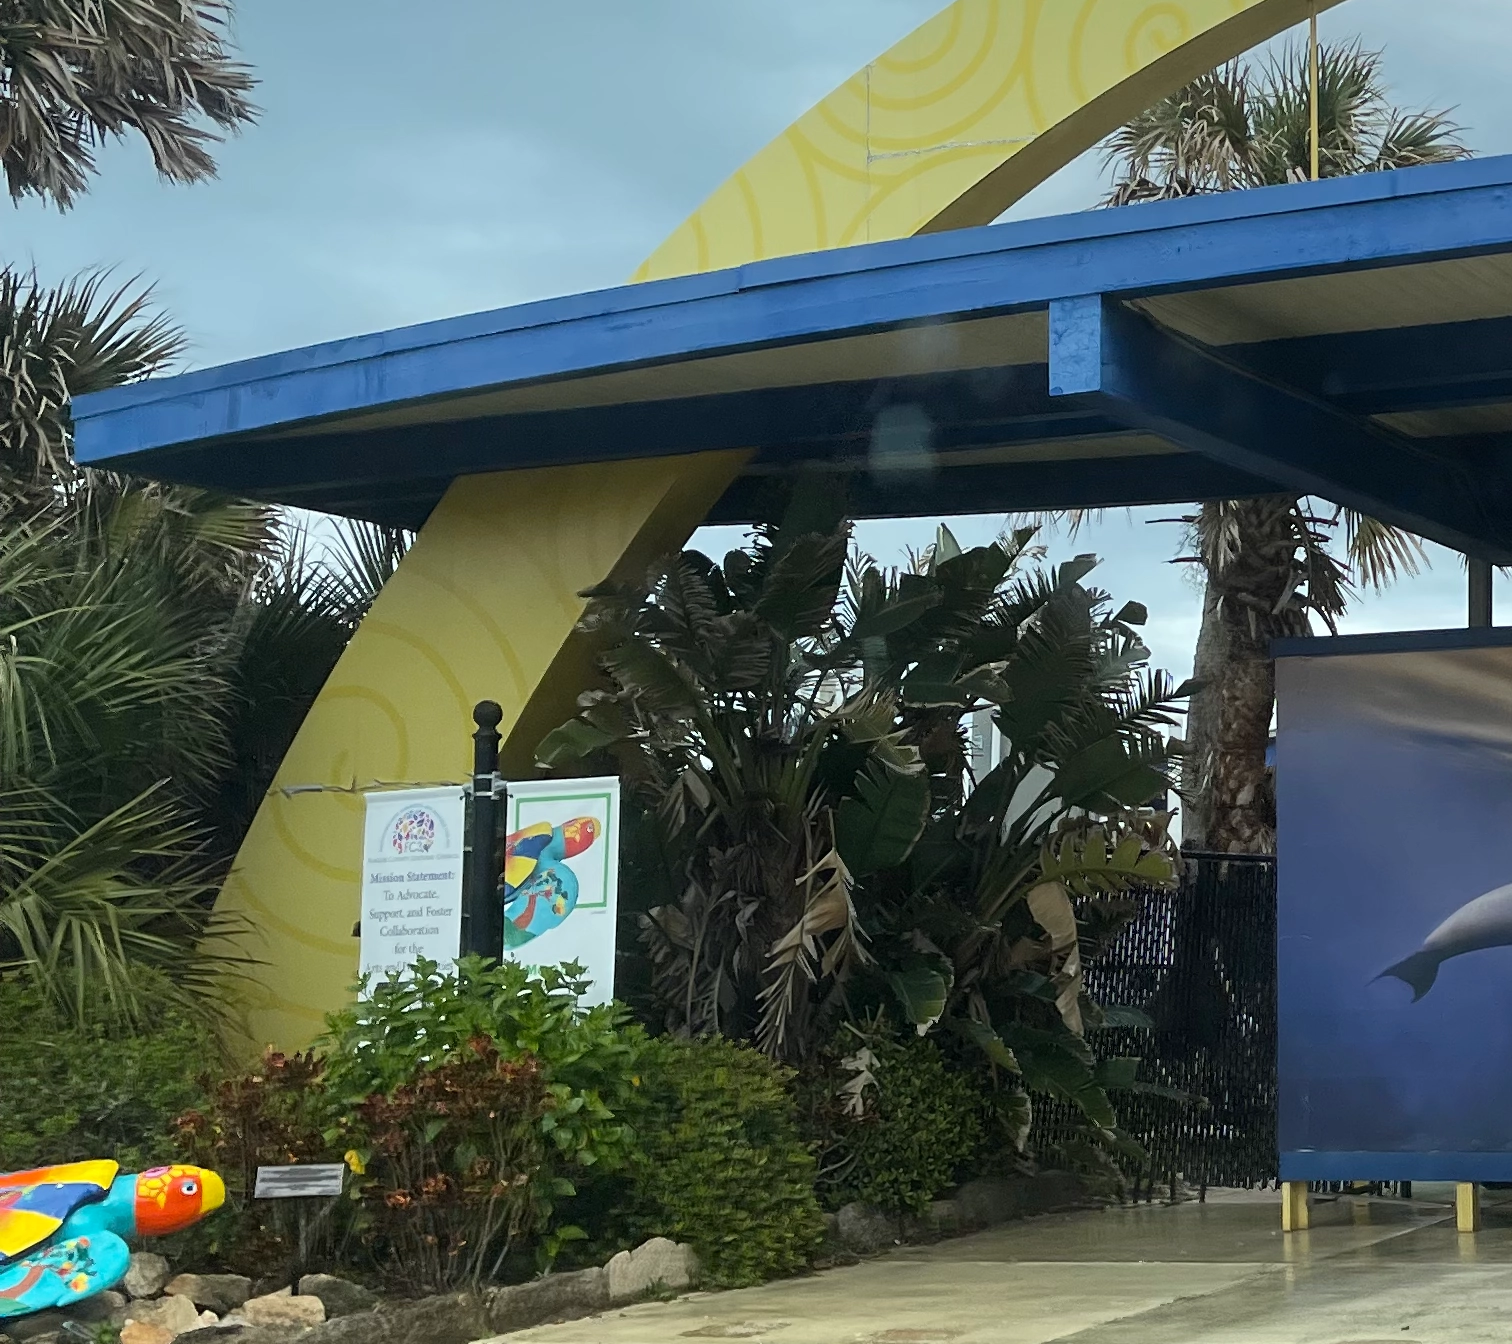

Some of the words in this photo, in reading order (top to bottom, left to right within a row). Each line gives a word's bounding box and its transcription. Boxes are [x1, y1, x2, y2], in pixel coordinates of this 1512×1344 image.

[370, 872, 404, 884] Mission
[383, 890, 394, 901] To
[407, 906, 423, 918] and
[426, 906, 453, 917] Foster
[380, 924, 439, 937] Collaboration
[395, 942, 406, 955] for
[408, 942, 424, 954] the
